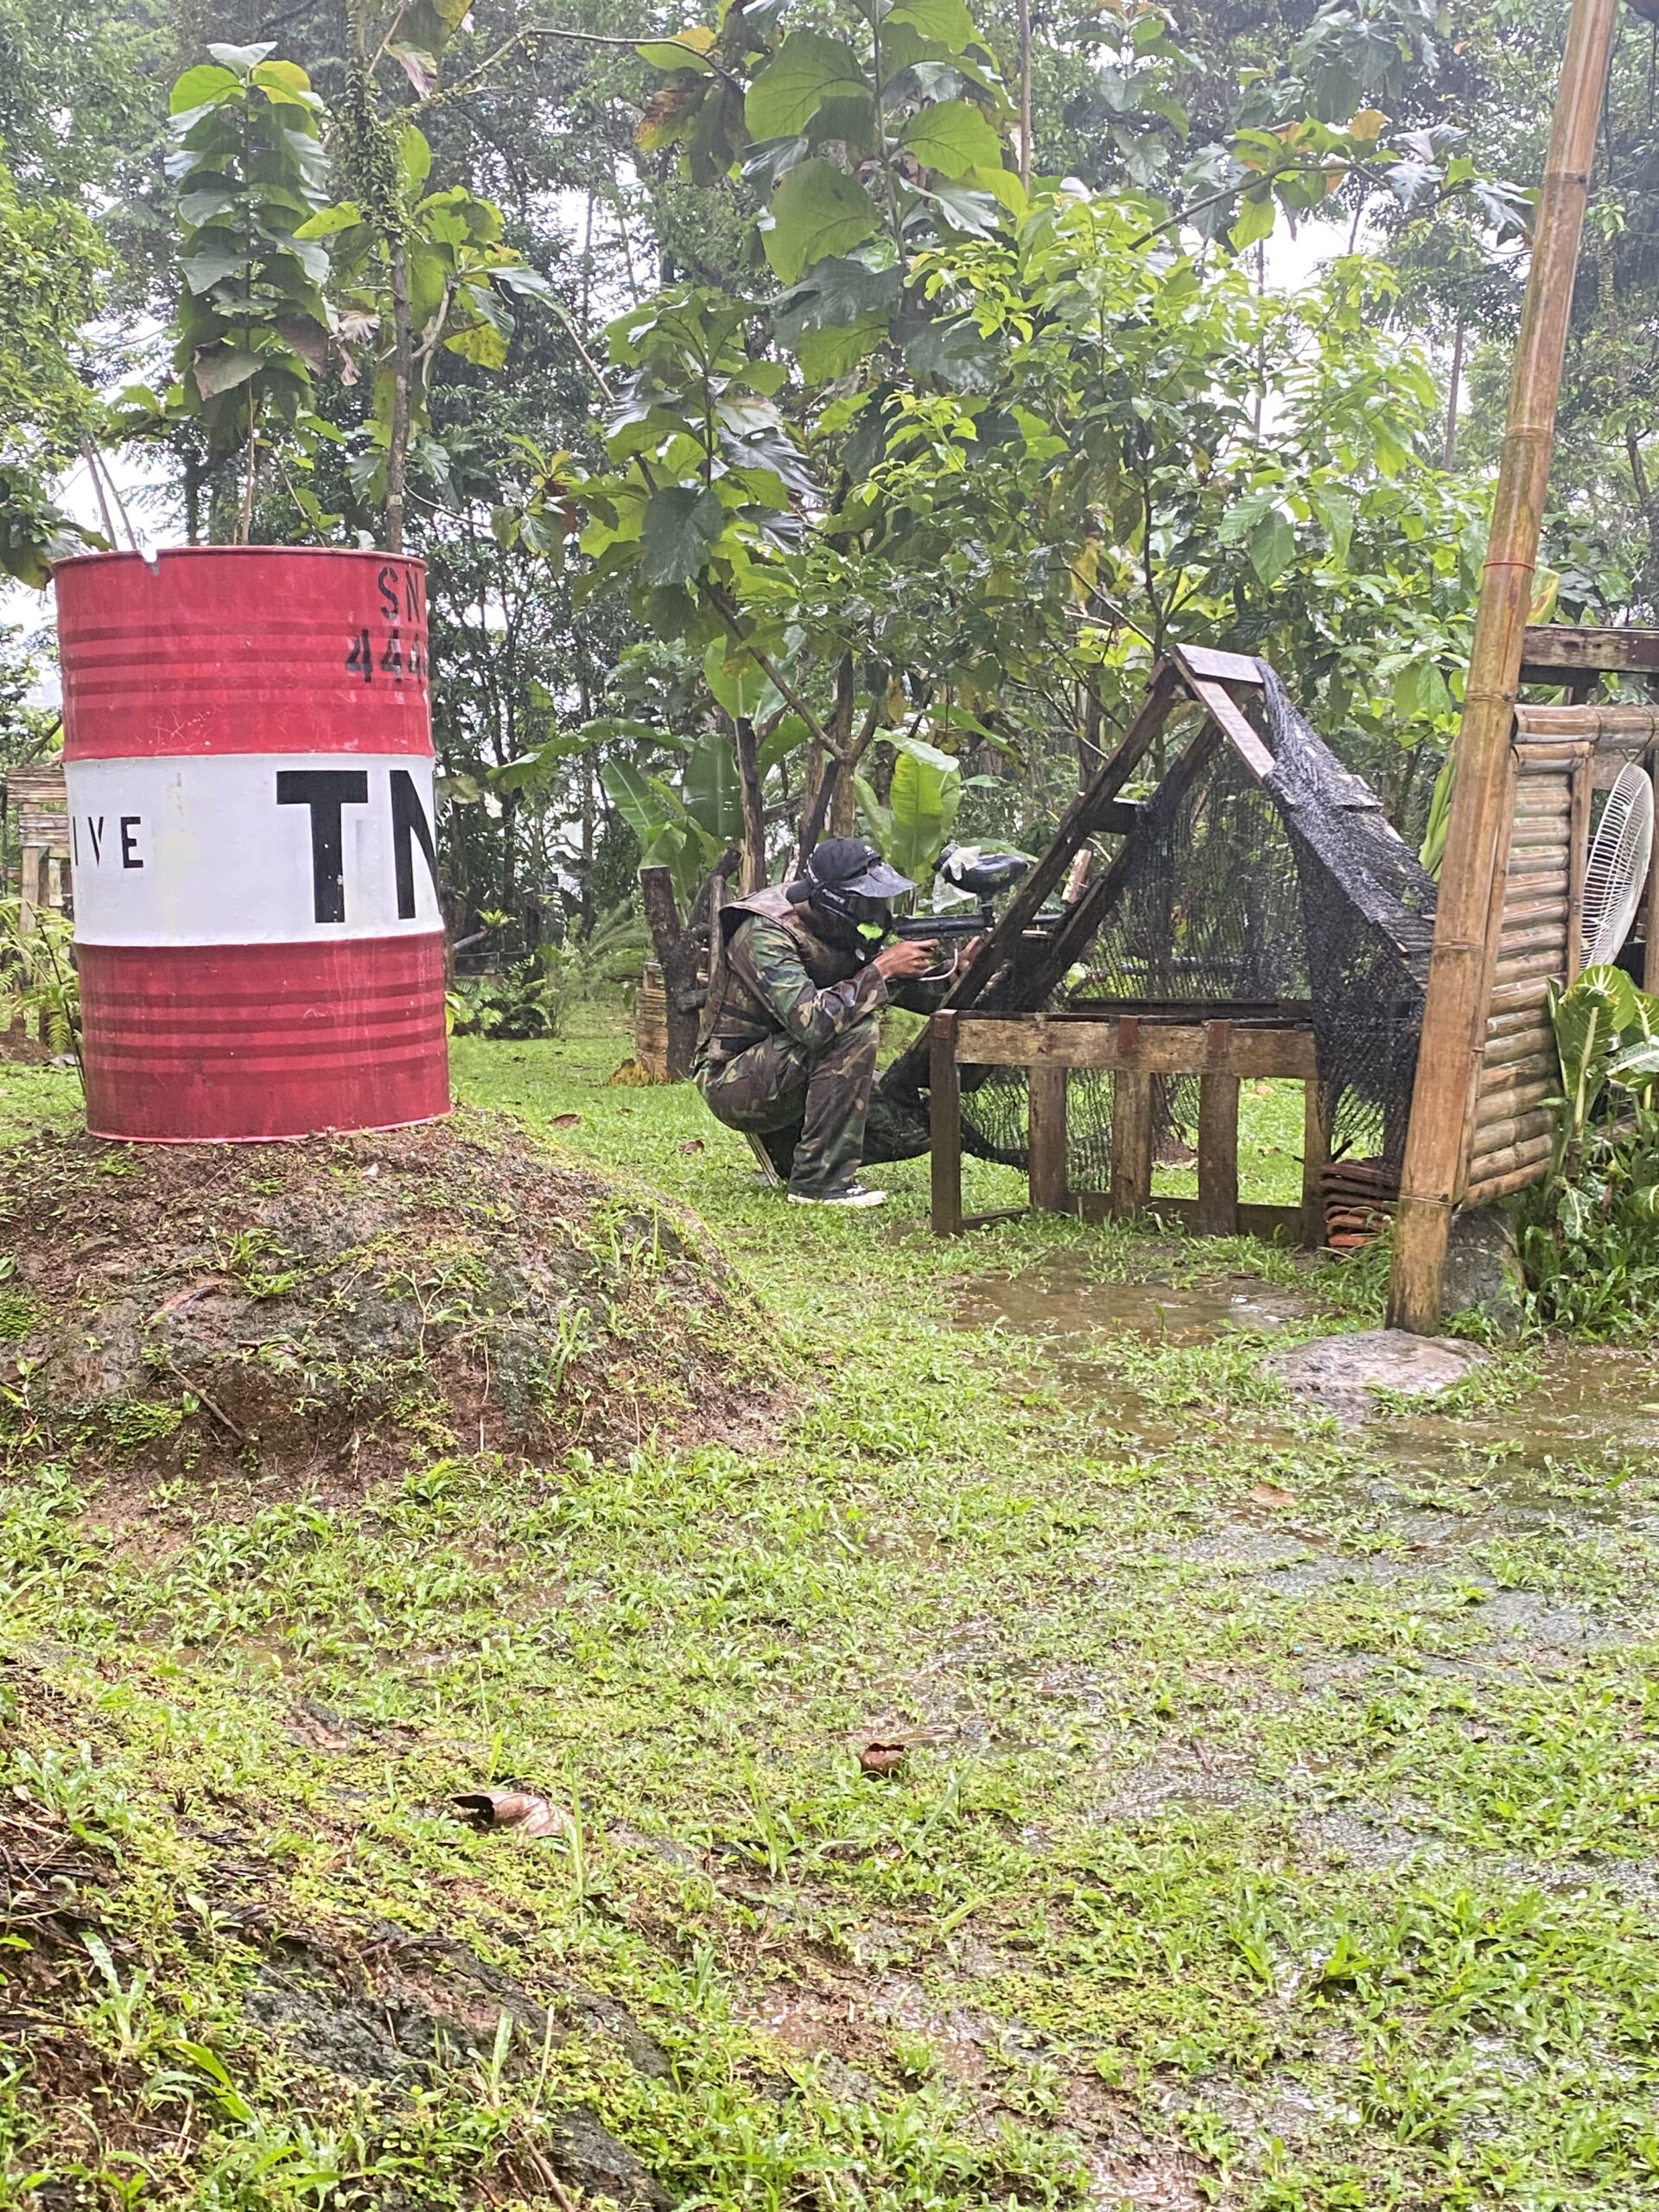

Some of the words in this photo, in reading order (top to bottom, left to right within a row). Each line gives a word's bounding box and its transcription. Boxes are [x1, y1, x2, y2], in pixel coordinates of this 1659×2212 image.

[378, 567, 420, 624] SN
[346, 628, 427, 684] 444
[73, 817, 143, 868] IVE
[276, 770, 442, 924] TN
